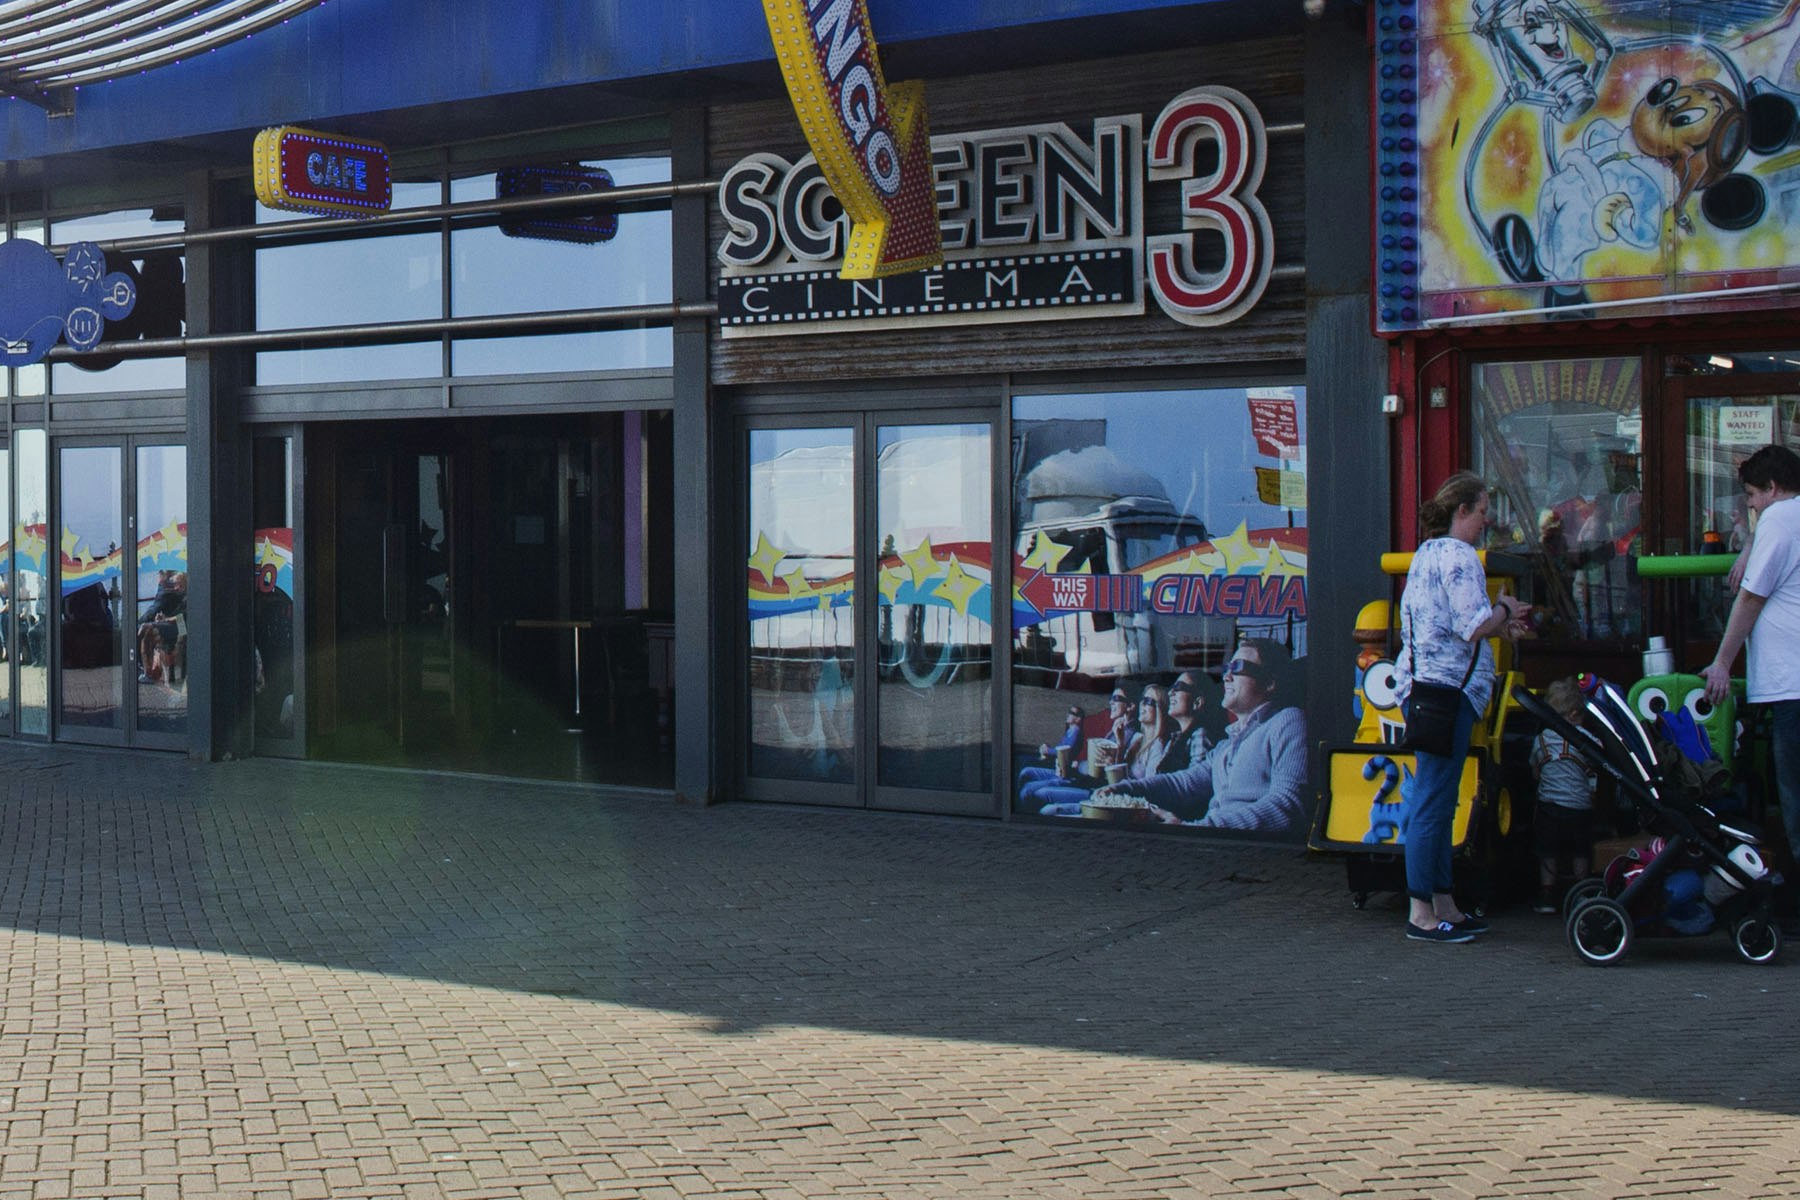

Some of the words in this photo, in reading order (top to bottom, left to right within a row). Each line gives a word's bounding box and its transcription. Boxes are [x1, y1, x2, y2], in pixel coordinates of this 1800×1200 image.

[306, 151, 367, 193] CAFE
[717, 122, 1130, 267] SCEEN
[1147, 92, 1256, 315] 3
[742, 265, 1093, 313] CINEMA
[1726, 421, 1766, 430] WANTED
[1732, 410, 1760, 419] STAFF
[1051, 578, 1088, 592] THIS
[1152, 576, 1307, 616] CINEMA
[1052, 593, 1087, 607] WAY
